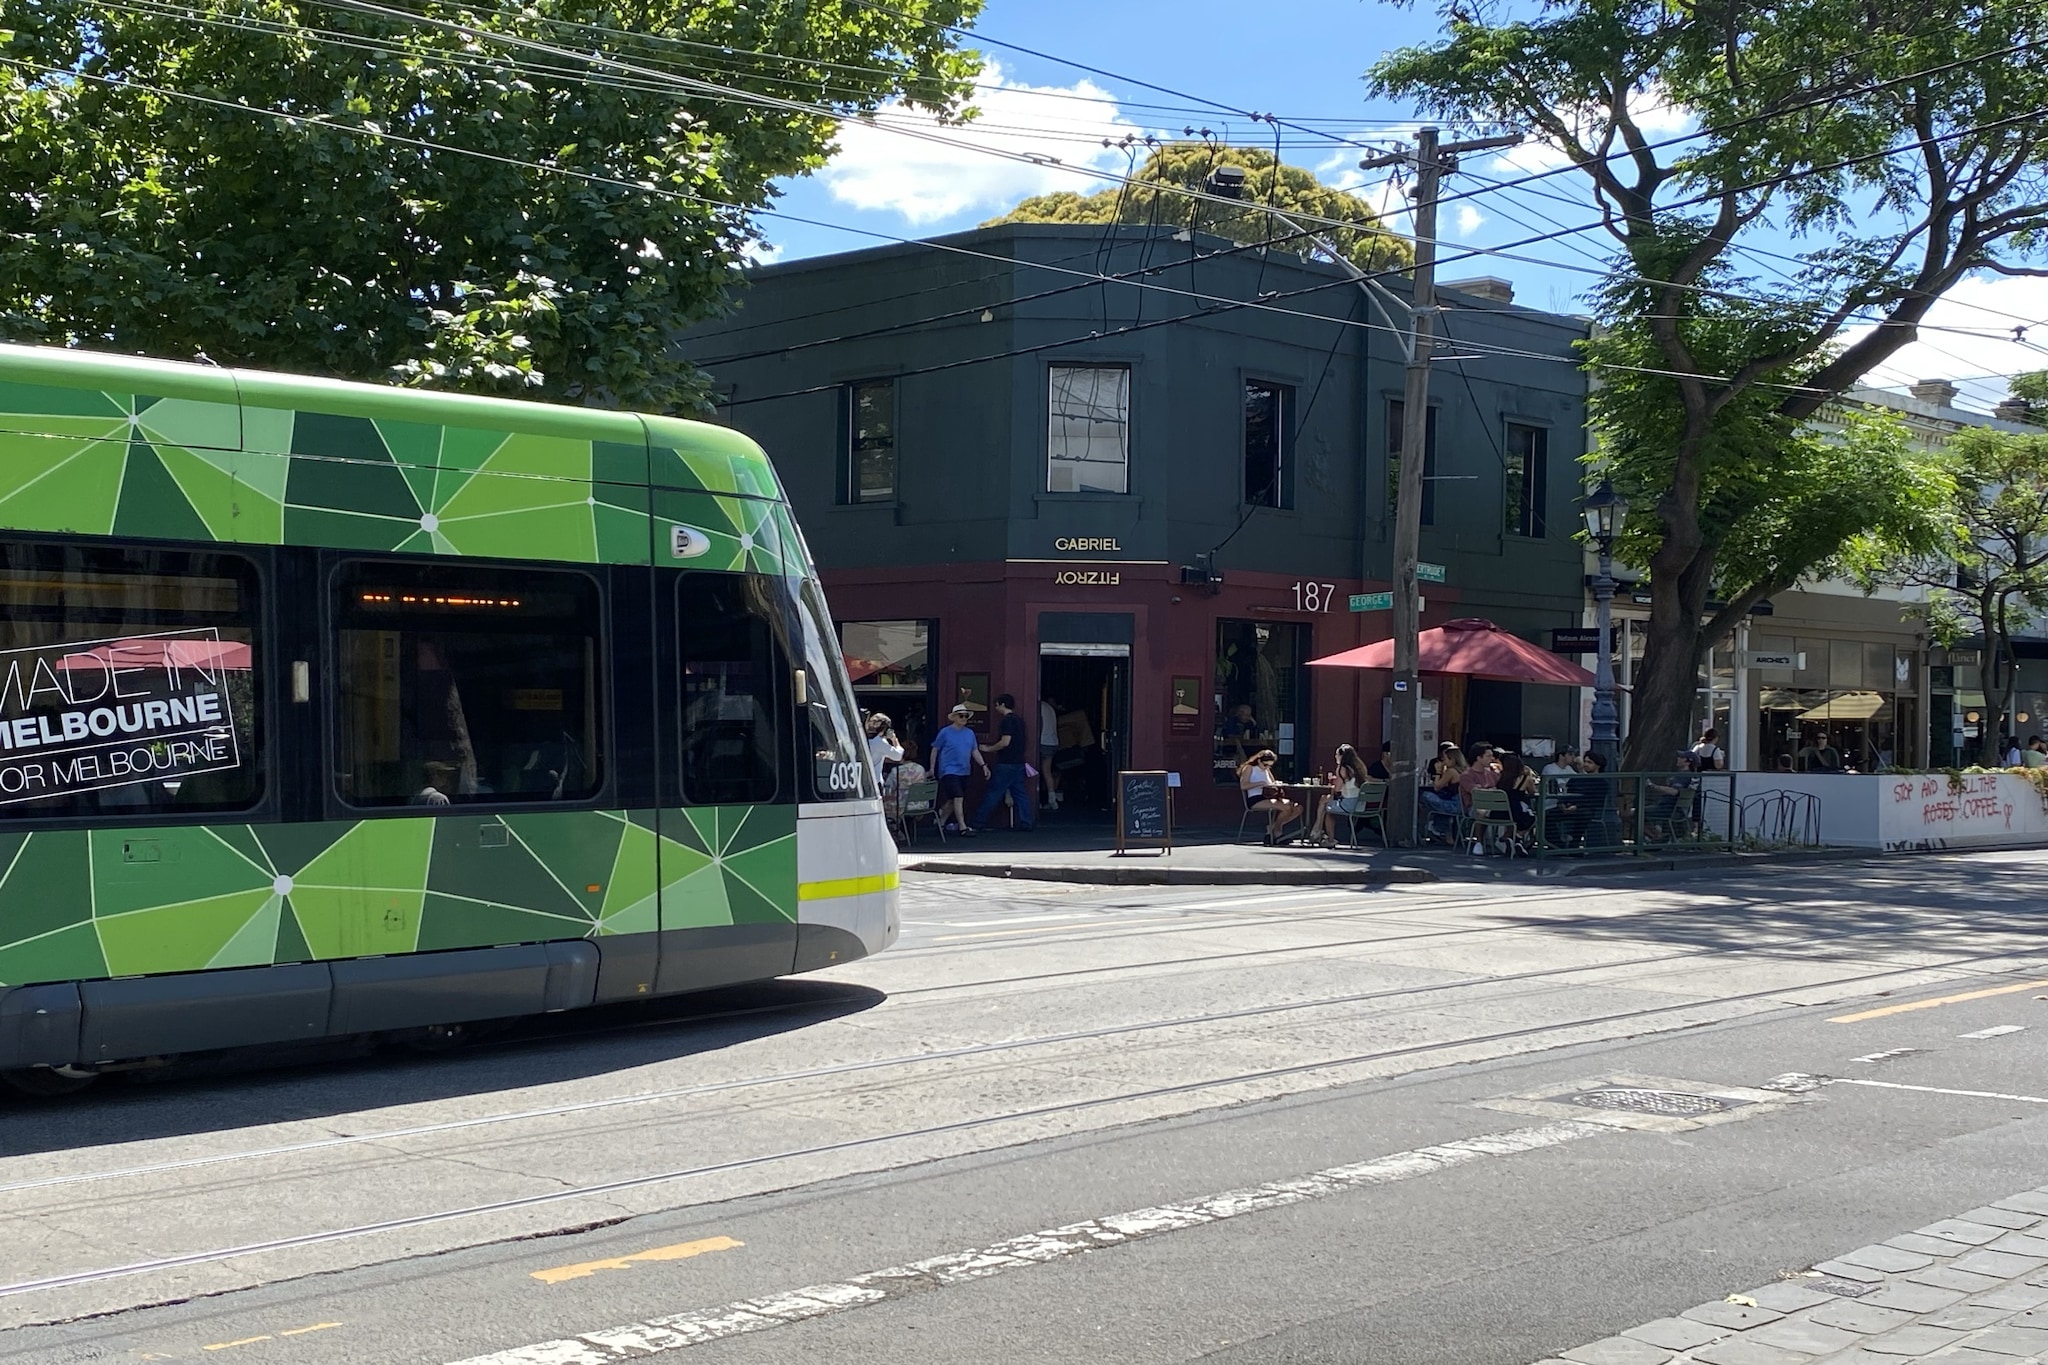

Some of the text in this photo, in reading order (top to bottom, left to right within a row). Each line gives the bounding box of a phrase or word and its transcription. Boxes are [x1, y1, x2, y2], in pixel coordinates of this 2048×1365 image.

[1054, 537, 1121, 551] GABRIEL
[1054, 571, 1120, 585] FITZROY
[1416, 564, 1441, 577] ERTRUDE
[1291, 581, 1335, 613] 187
[1349, 595, 1383, 607] GEORGE
[163, 638, 217, 691] IN
[0, 737, 229, 793] OR MELBOURNE
[829, 762, 864, 799] 6037
[1893, 782, 1914, 803] STOP
[1921, 779, 1939, 799] AND
[1978, 776, 1997, 793] THE
